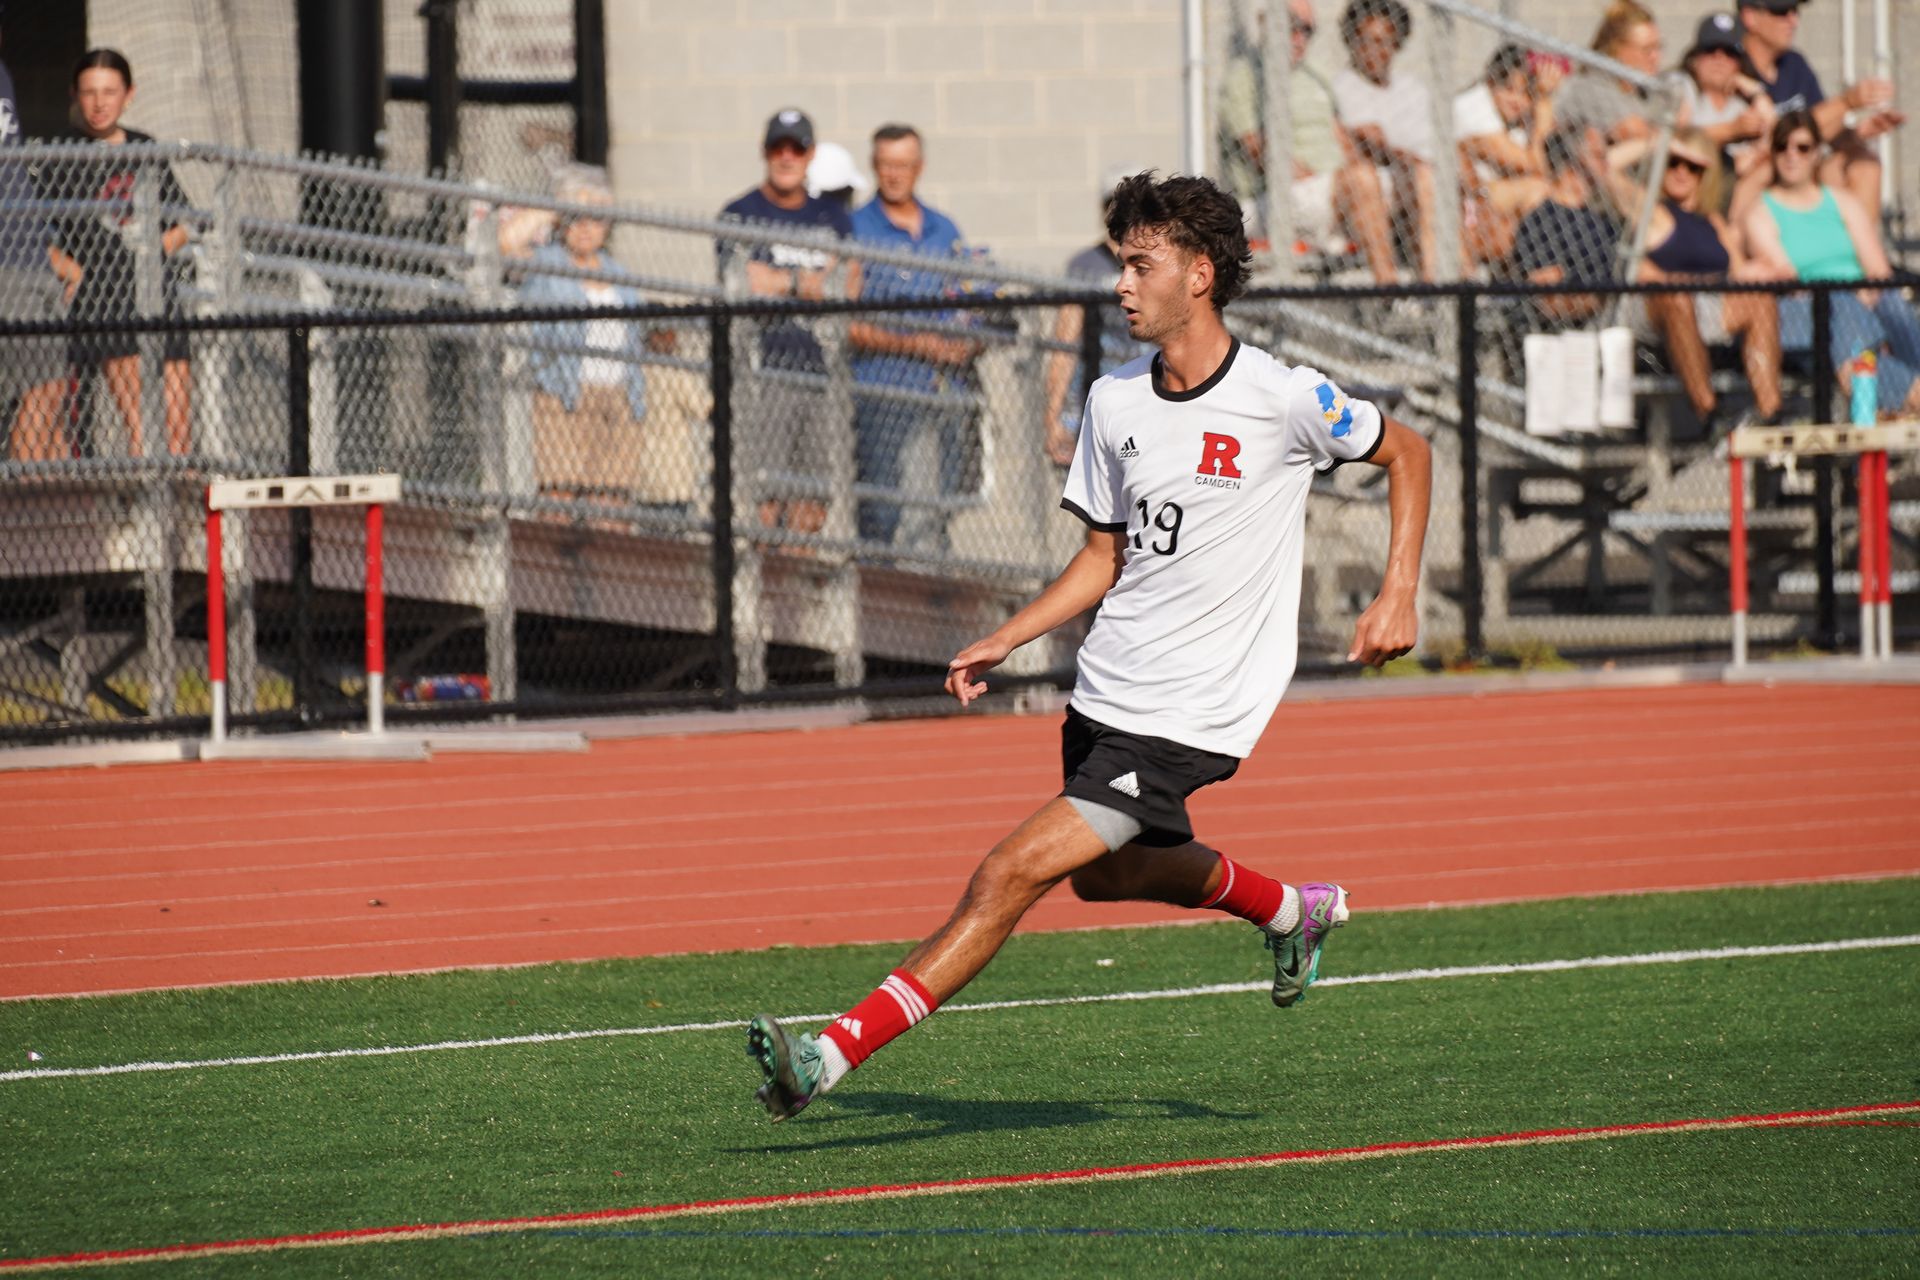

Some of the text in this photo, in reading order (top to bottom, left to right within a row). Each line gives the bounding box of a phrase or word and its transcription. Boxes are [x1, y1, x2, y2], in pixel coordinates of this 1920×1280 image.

[1197, 432, 1242, 479] R
[1195, 476, 1241, 490] CAMDEN
[1134, 499, 1183, 556] 19
